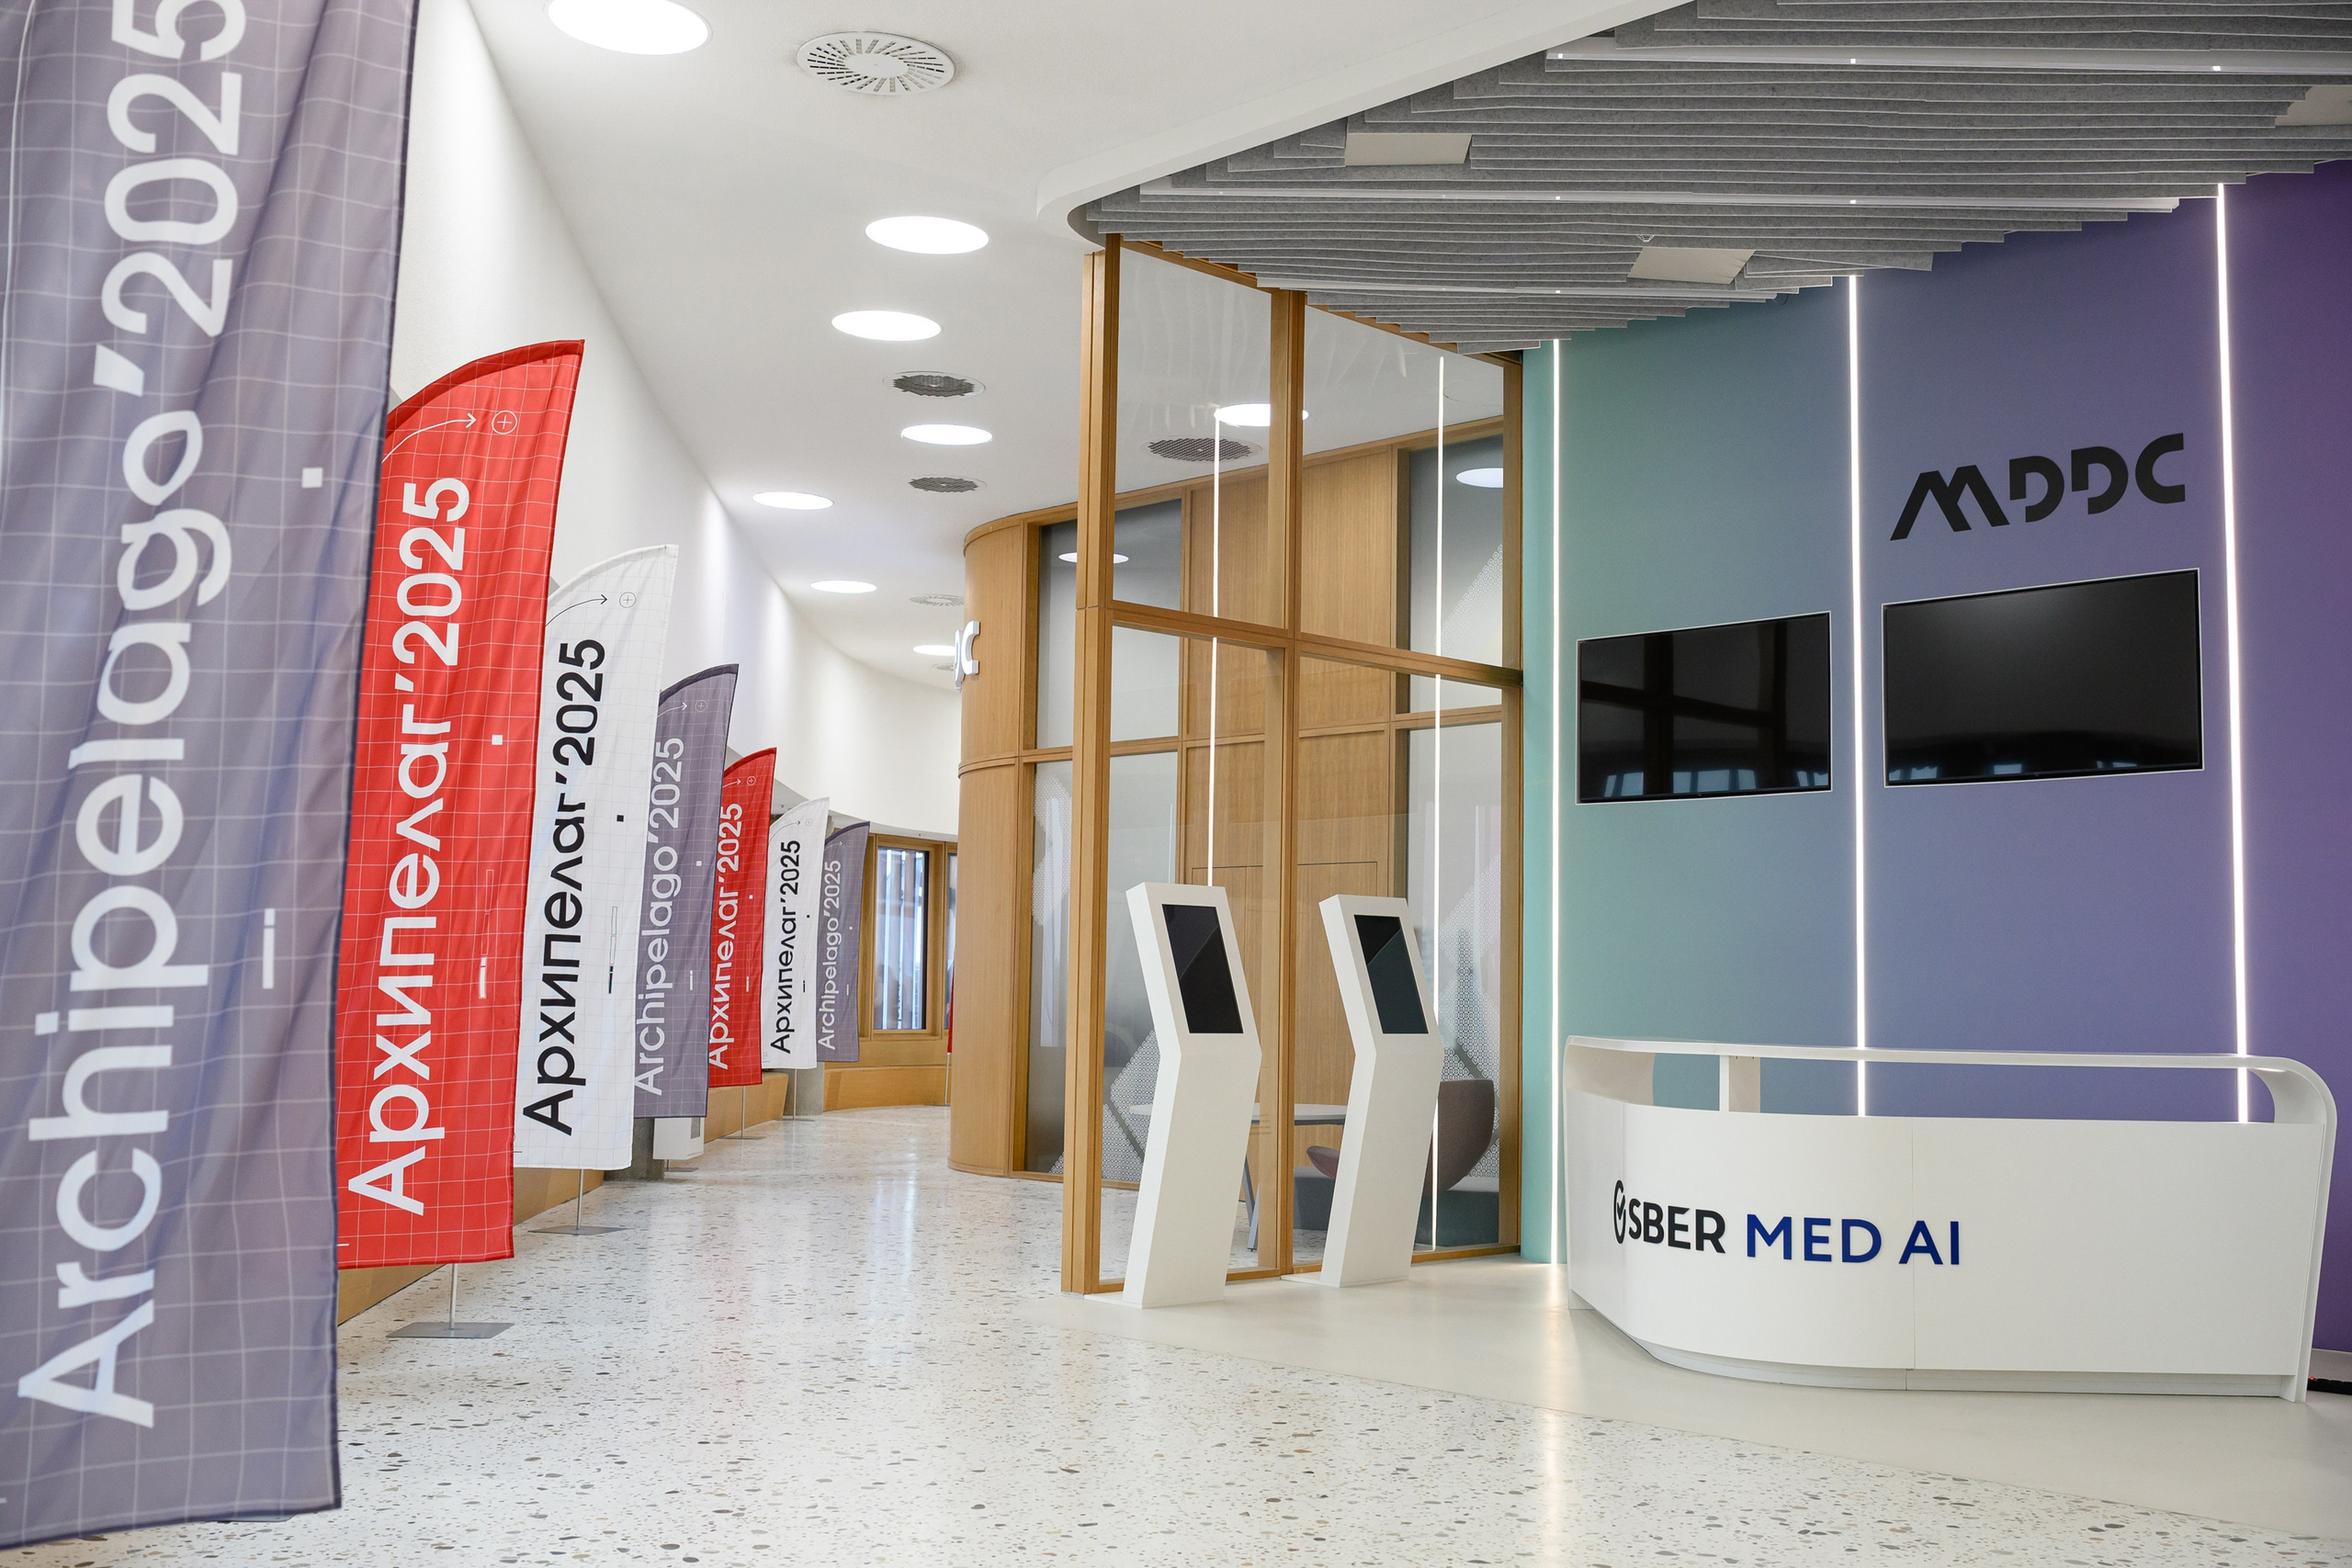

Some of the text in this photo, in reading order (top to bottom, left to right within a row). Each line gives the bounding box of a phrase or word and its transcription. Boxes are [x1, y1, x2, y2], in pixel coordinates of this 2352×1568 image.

[1889, 432, 2187, 541] MDDC
[348, 477, 470, 1216] Архипелаг'2025
[522, 638, 605, 1137] Архипелаг'2025
[634, 738, 684, 1096] Archipelago'2025
[709, 803, 742, 1069] Архипелаг'2025
[770, 840, 800, 1054] Архипелаг'2025
[818, 860, 842, 1050] Archipelago'2025
[1628, 1197, 1960, 1266] SBER MED AI
